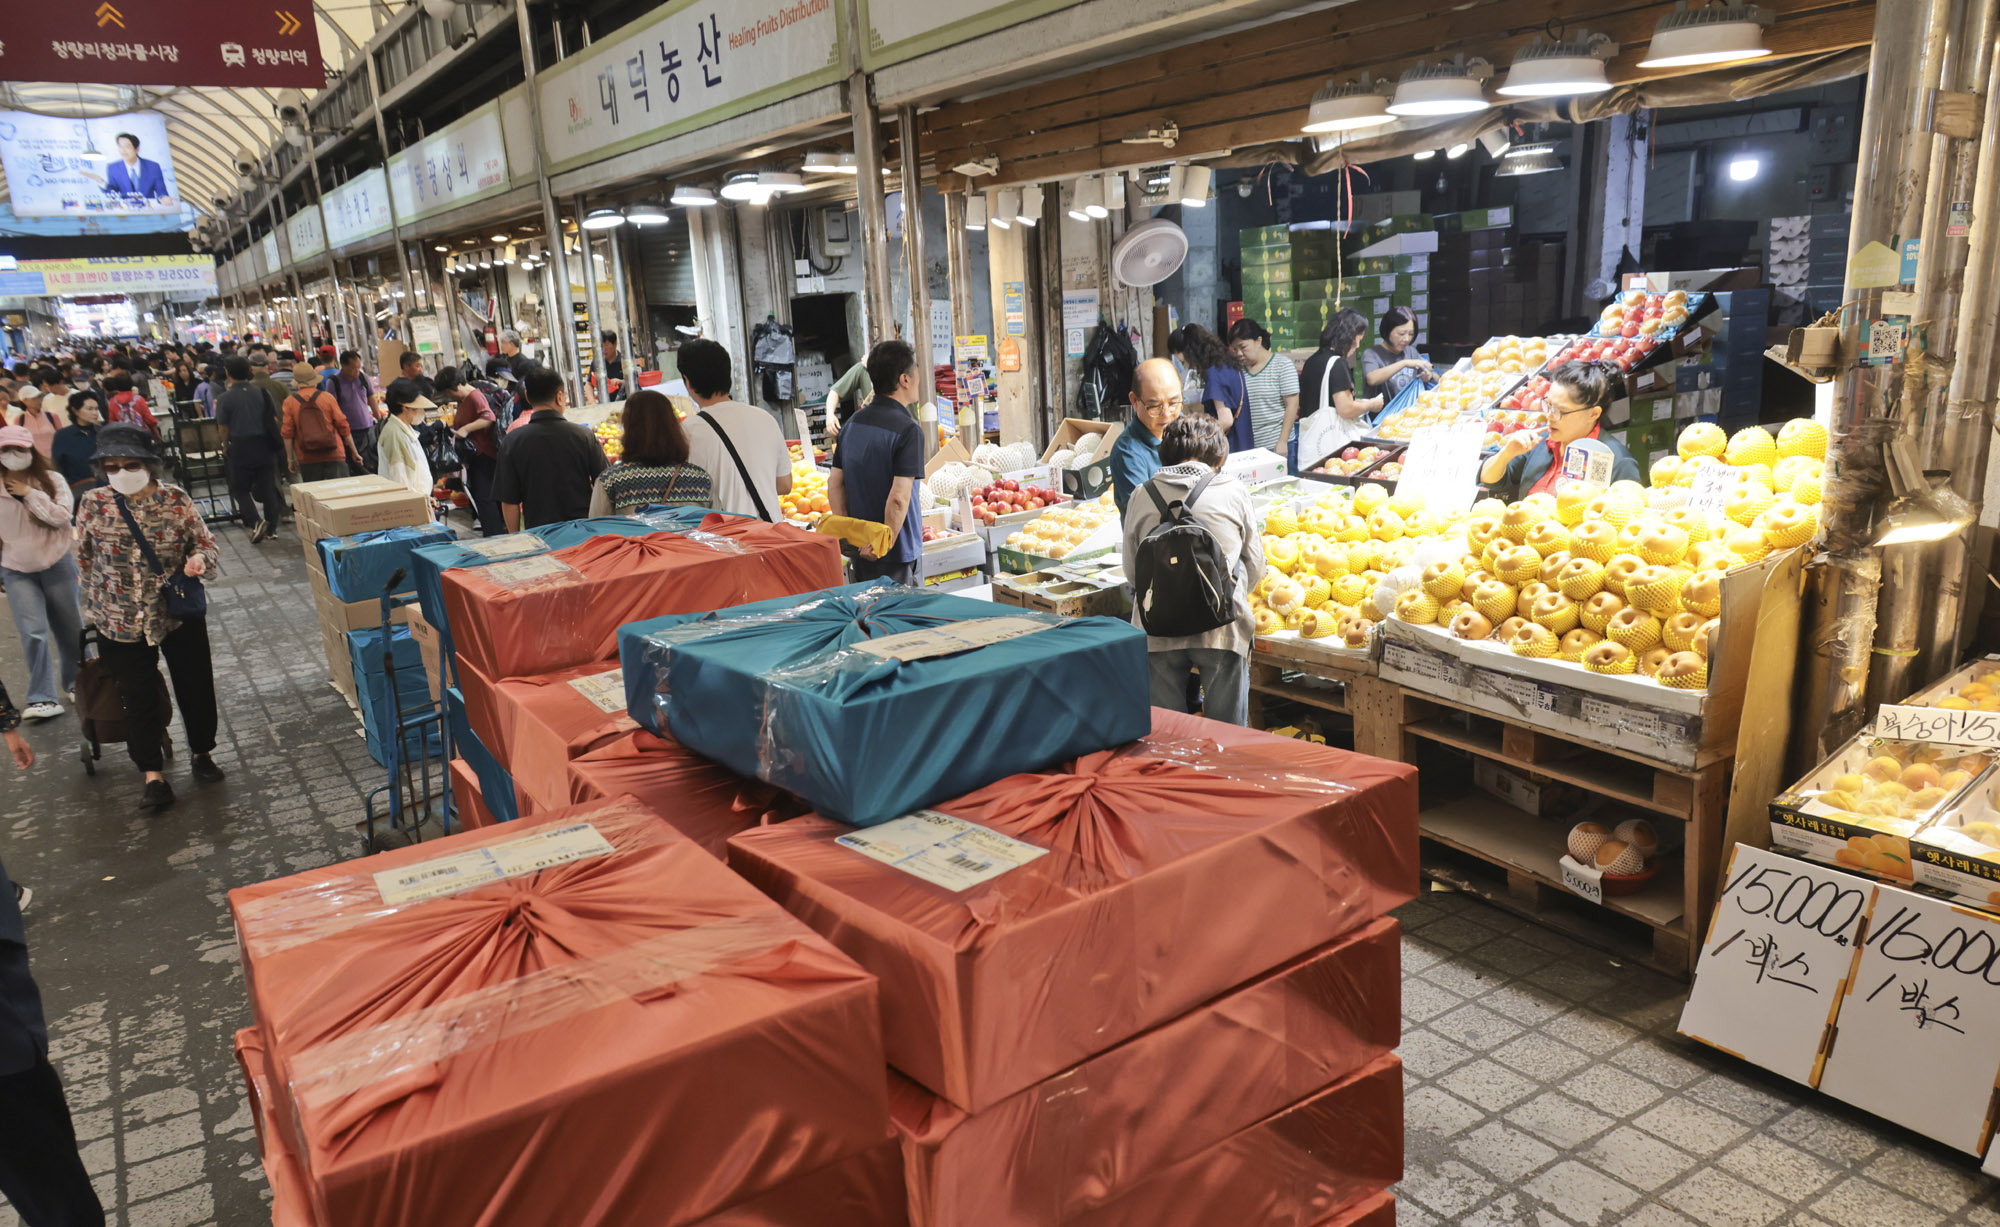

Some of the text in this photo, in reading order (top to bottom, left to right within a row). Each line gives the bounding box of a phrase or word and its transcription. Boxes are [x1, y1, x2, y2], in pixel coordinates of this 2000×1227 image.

[729, 0, 829, 51] Healing Fruits Distribution
[52, 40, 179, 62] 청량리청과물시장
[252, 48, 308, 66] 청량리역
[598, 12, 722, 126] 대덕농산
[1783, 813, 1820, 832] 햇사레
[1926, 851, 1970, 873] 햇사레
